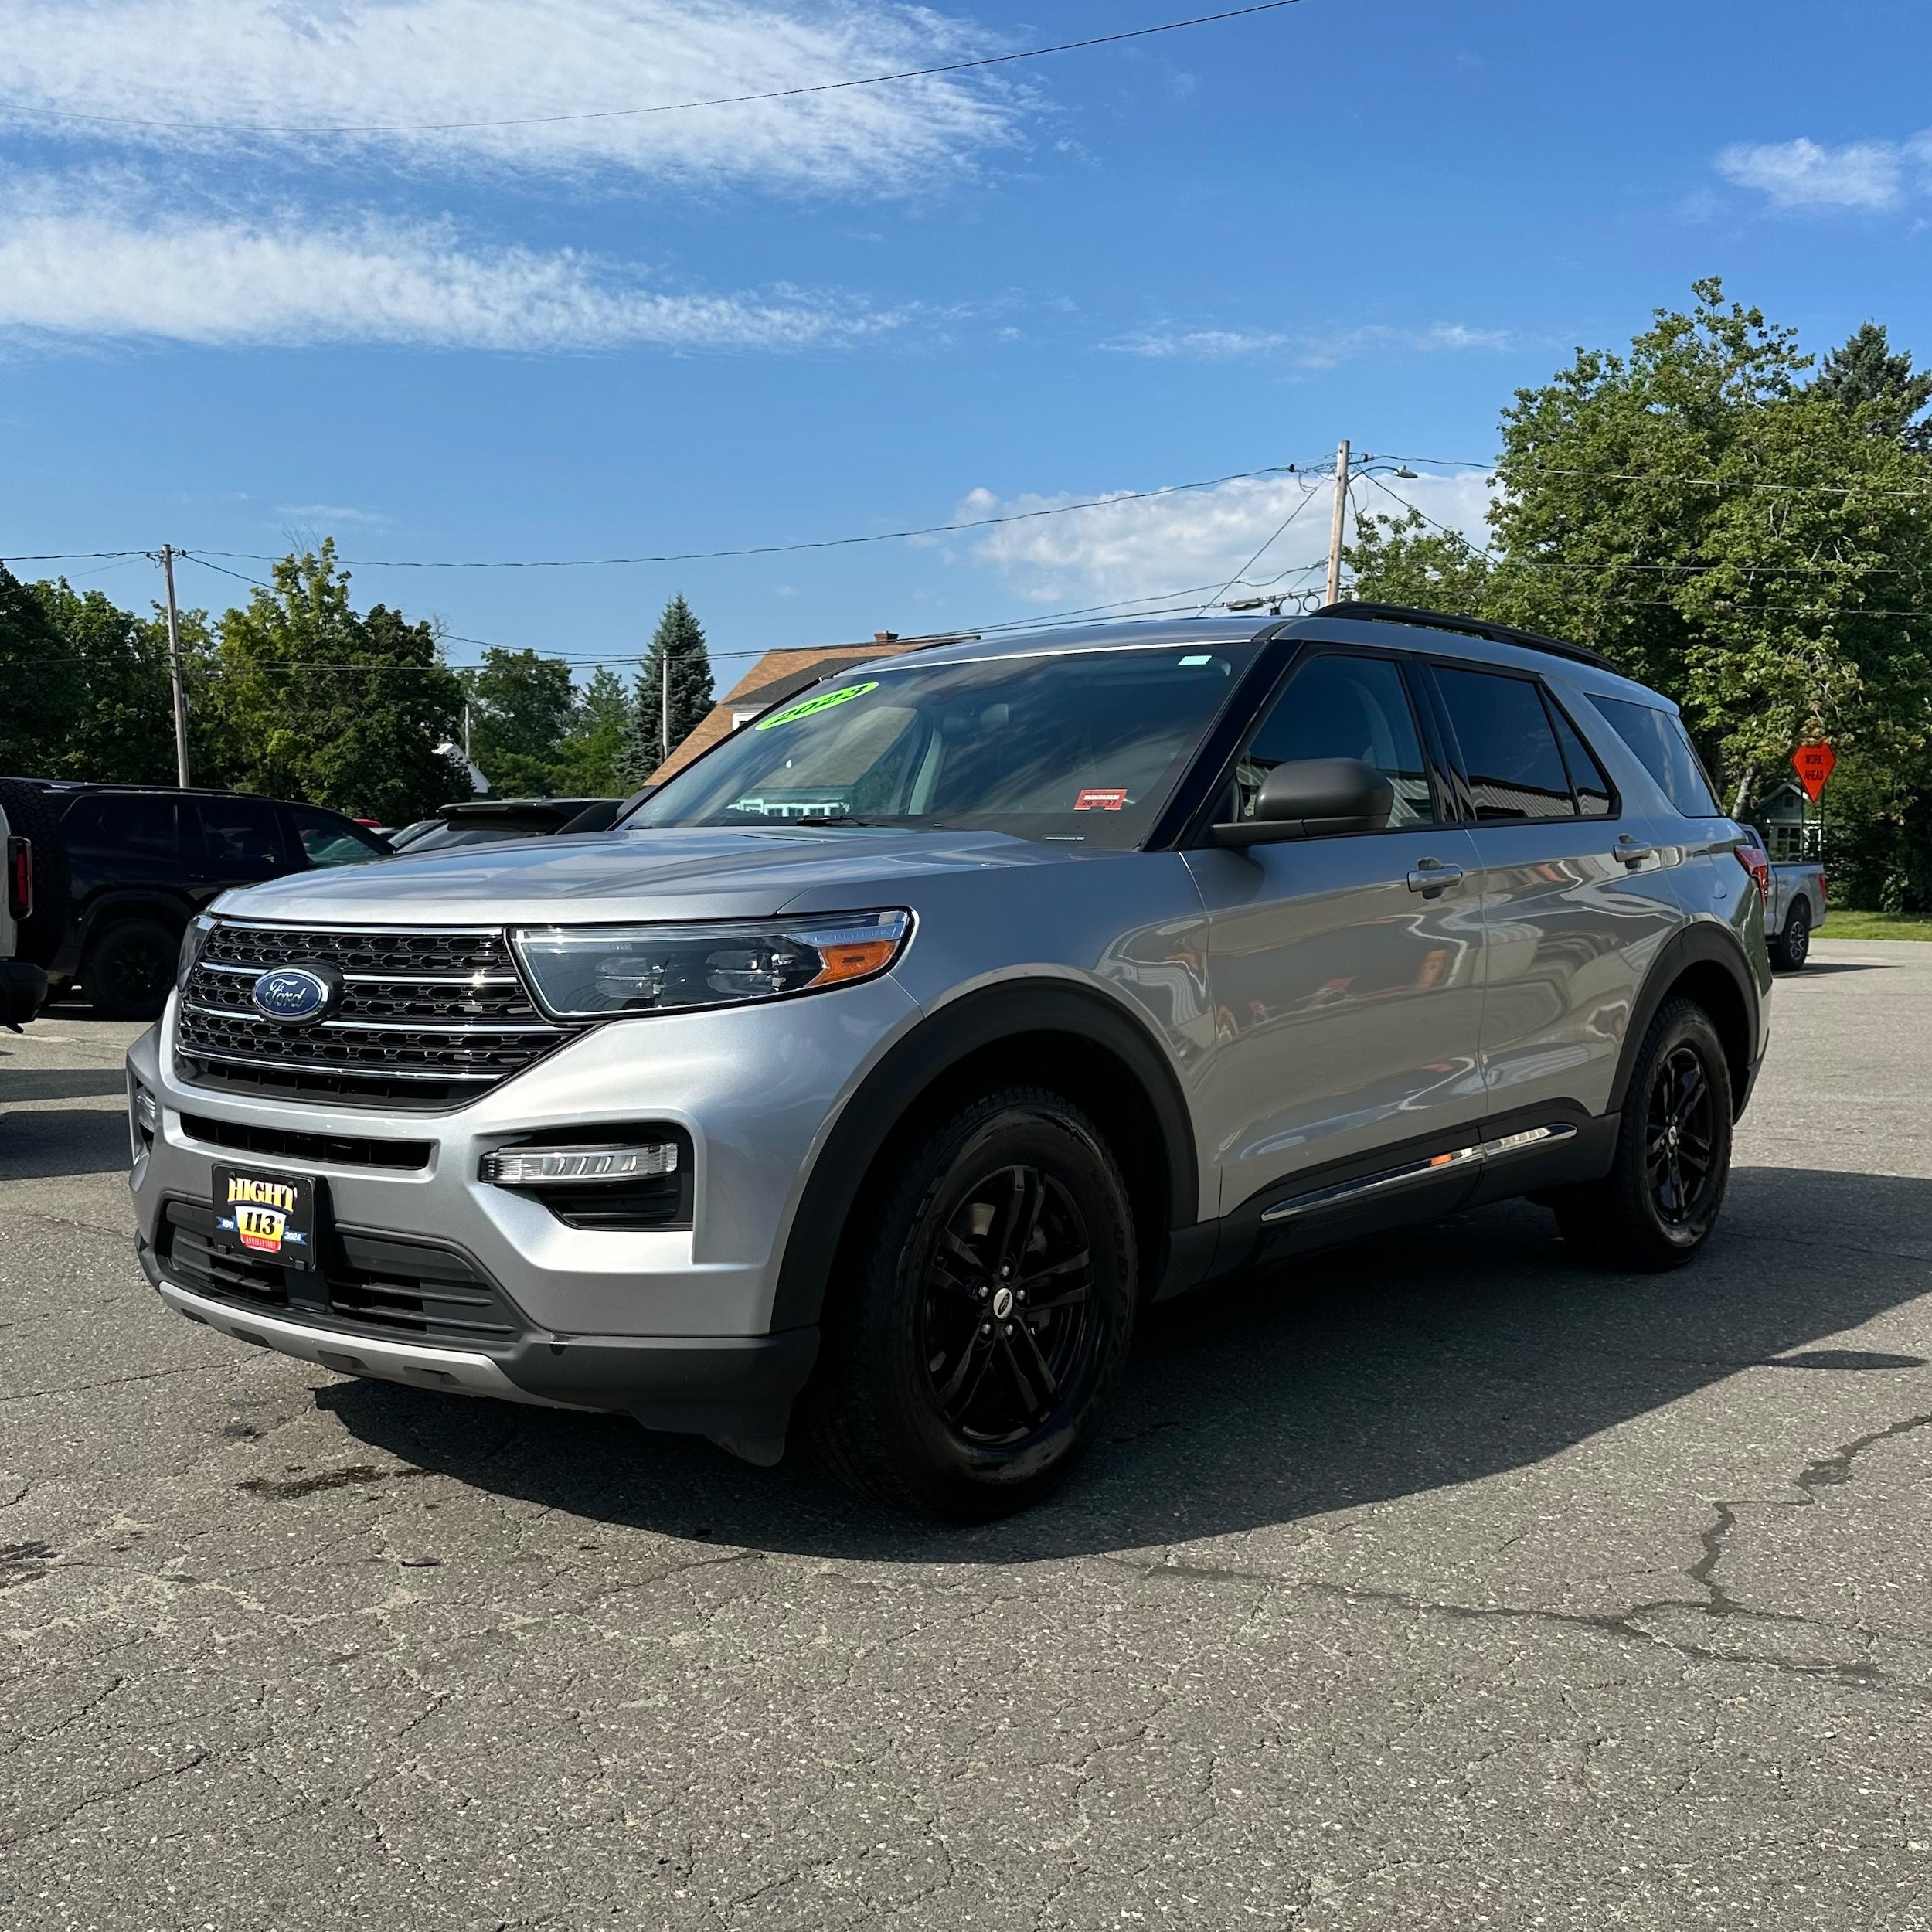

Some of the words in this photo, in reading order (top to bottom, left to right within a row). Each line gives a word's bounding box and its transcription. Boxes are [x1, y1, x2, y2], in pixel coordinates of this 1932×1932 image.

[767, 685, 869, 726] 2023
[1805, 754, 1823, 764] WORK
[1804, 770, 1825, 781] AHEAD
[265, 978, 307, 1008] Ford
[227, 1177, 298, 1213] HIGHT
[284, 1231, 301, 1241] 2024
